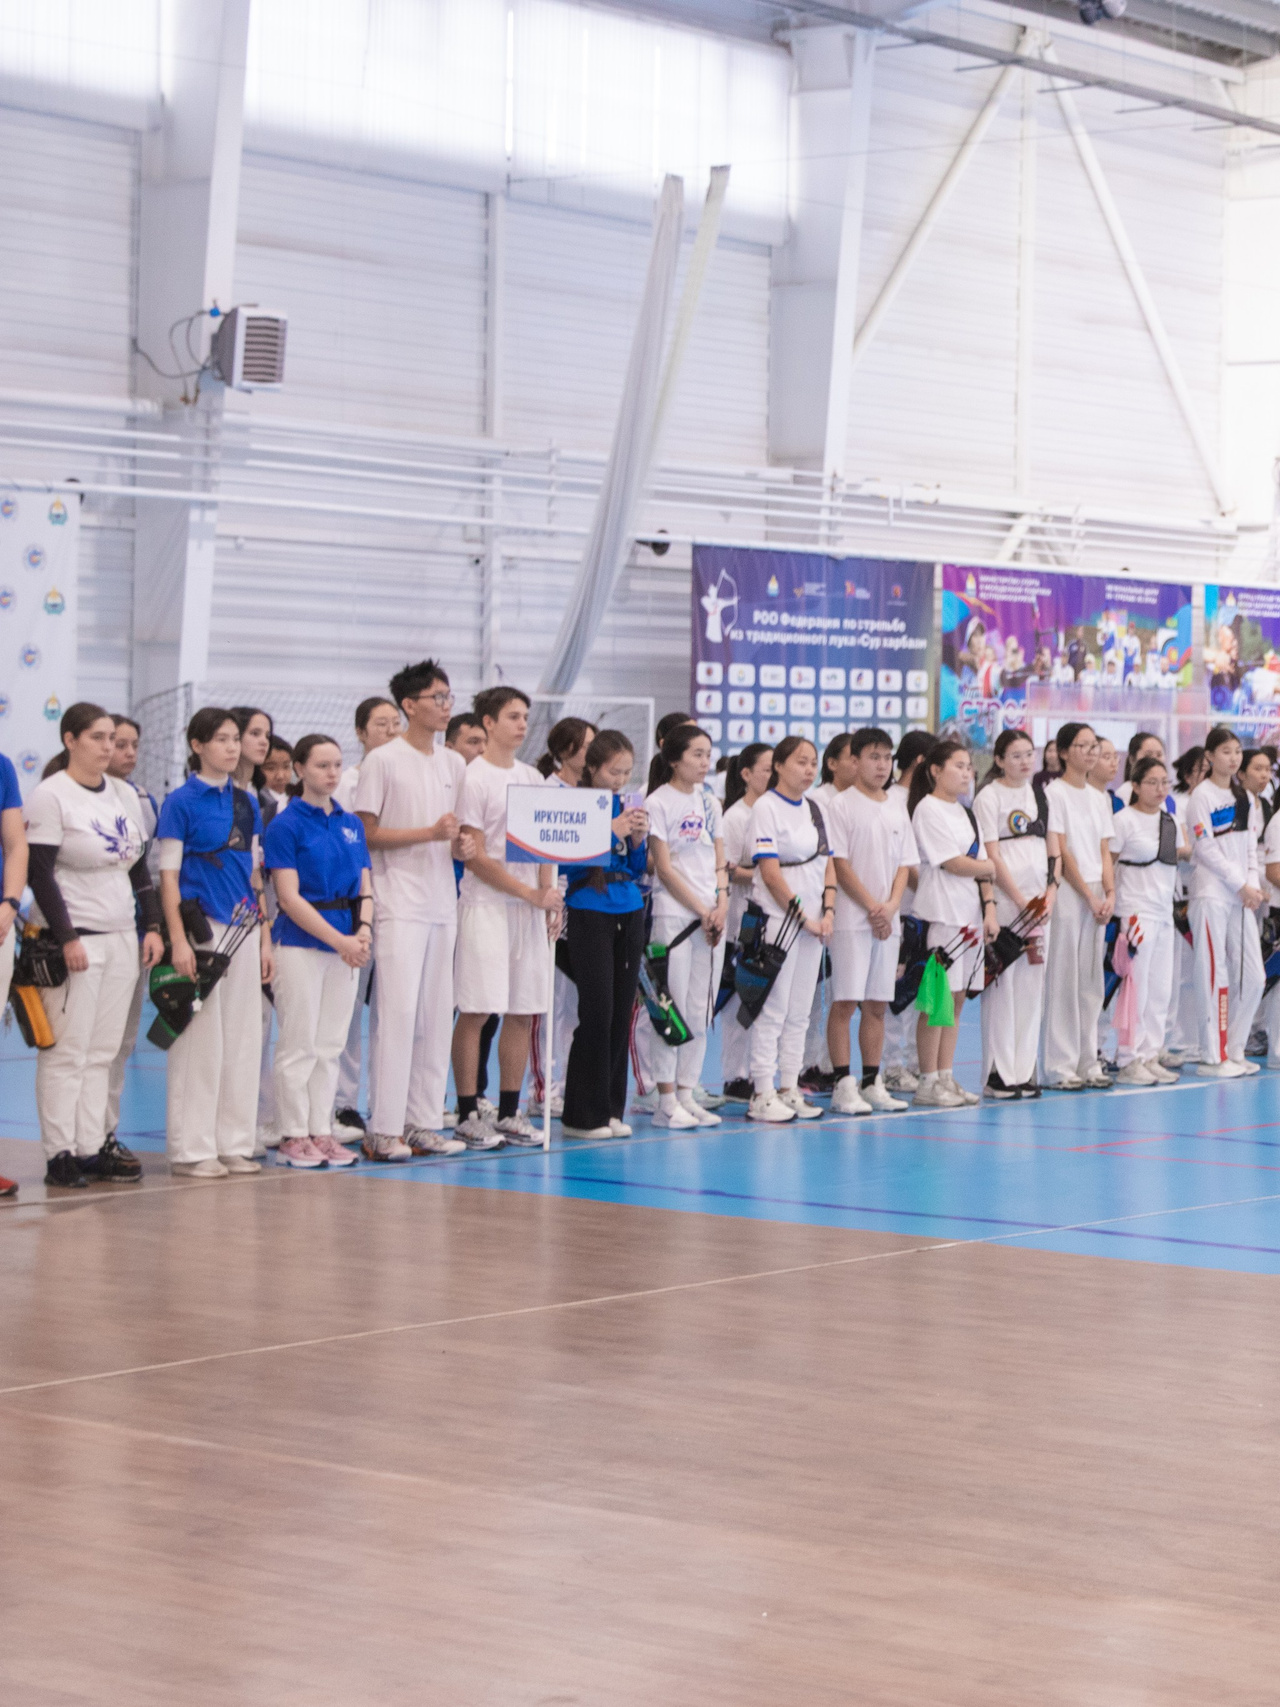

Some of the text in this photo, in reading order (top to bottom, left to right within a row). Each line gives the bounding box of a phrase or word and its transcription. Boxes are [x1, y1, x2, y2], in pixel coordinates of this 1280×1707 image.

[753, 610, 778, 626] РОО
[534, 810, 587, 824] ИРКУТСКАЯ
[540, 829, 580, 843] ОБЛАСТЬ
